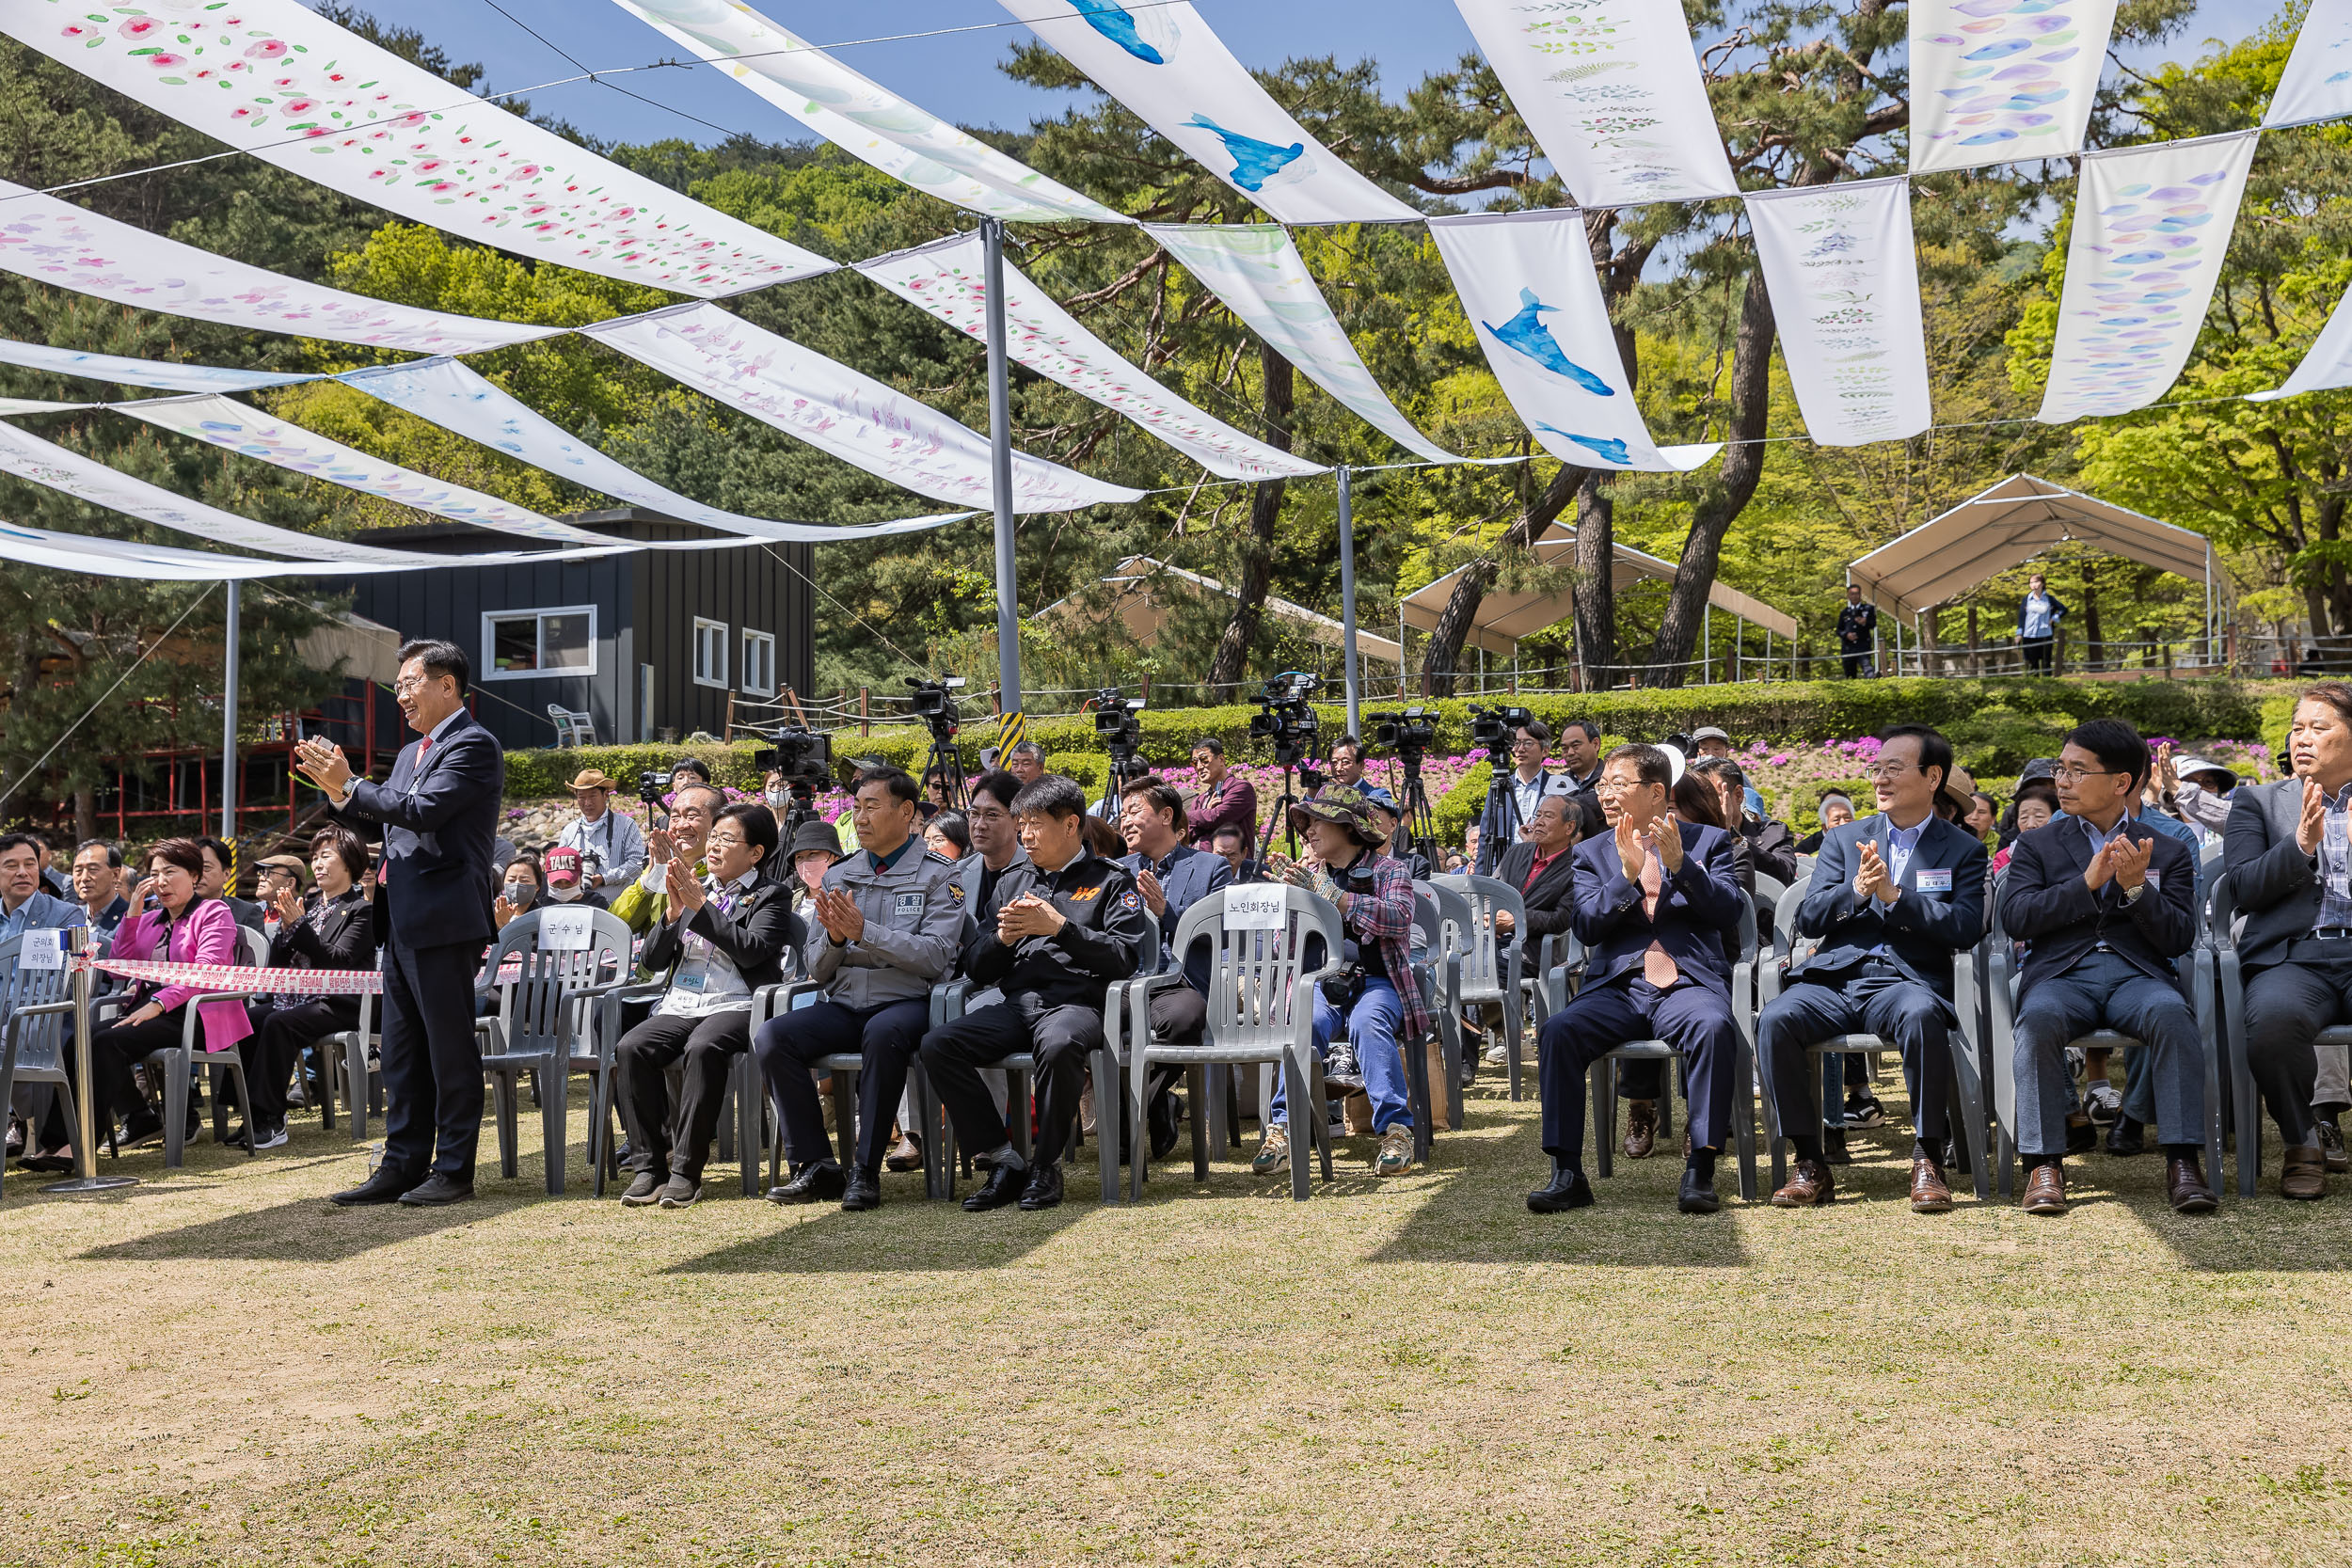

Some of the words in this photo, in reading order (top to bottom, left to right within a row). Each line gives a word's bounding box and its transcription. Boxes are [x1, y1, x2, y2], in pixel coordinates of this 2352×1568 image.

[549, 855, 575, 870] TAKE
[1070, 887, 1101, 901] 119
[898, 895, 921, 906] 경찰
[1229, 900, 1279, 913] 노인회장님
[33, 937, 55, 948] 군의회
[31, 953, 54, 964] 의장님
